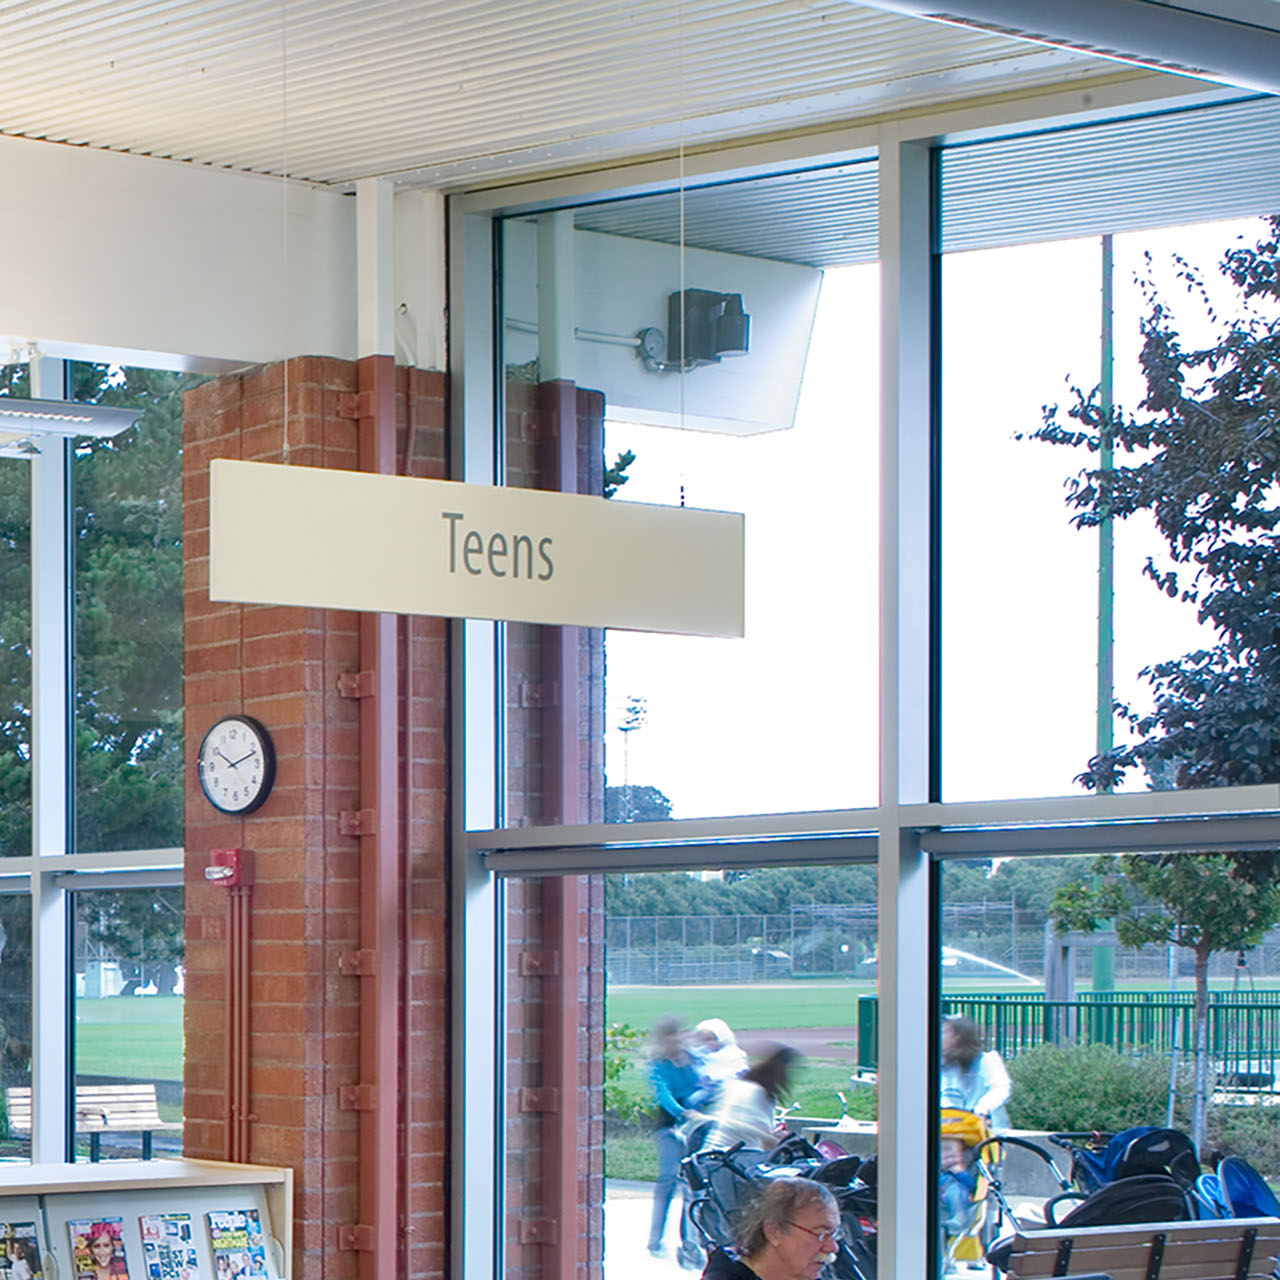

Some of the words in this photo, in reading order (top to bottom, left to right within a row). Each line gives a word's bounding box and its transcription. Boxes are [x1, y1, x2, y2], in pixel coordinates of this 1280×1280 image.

[441, 511, 554, 581] Teens
[159, 1250, 184, 1260] BEST
[160, 1260, 184, 1270] NEW
